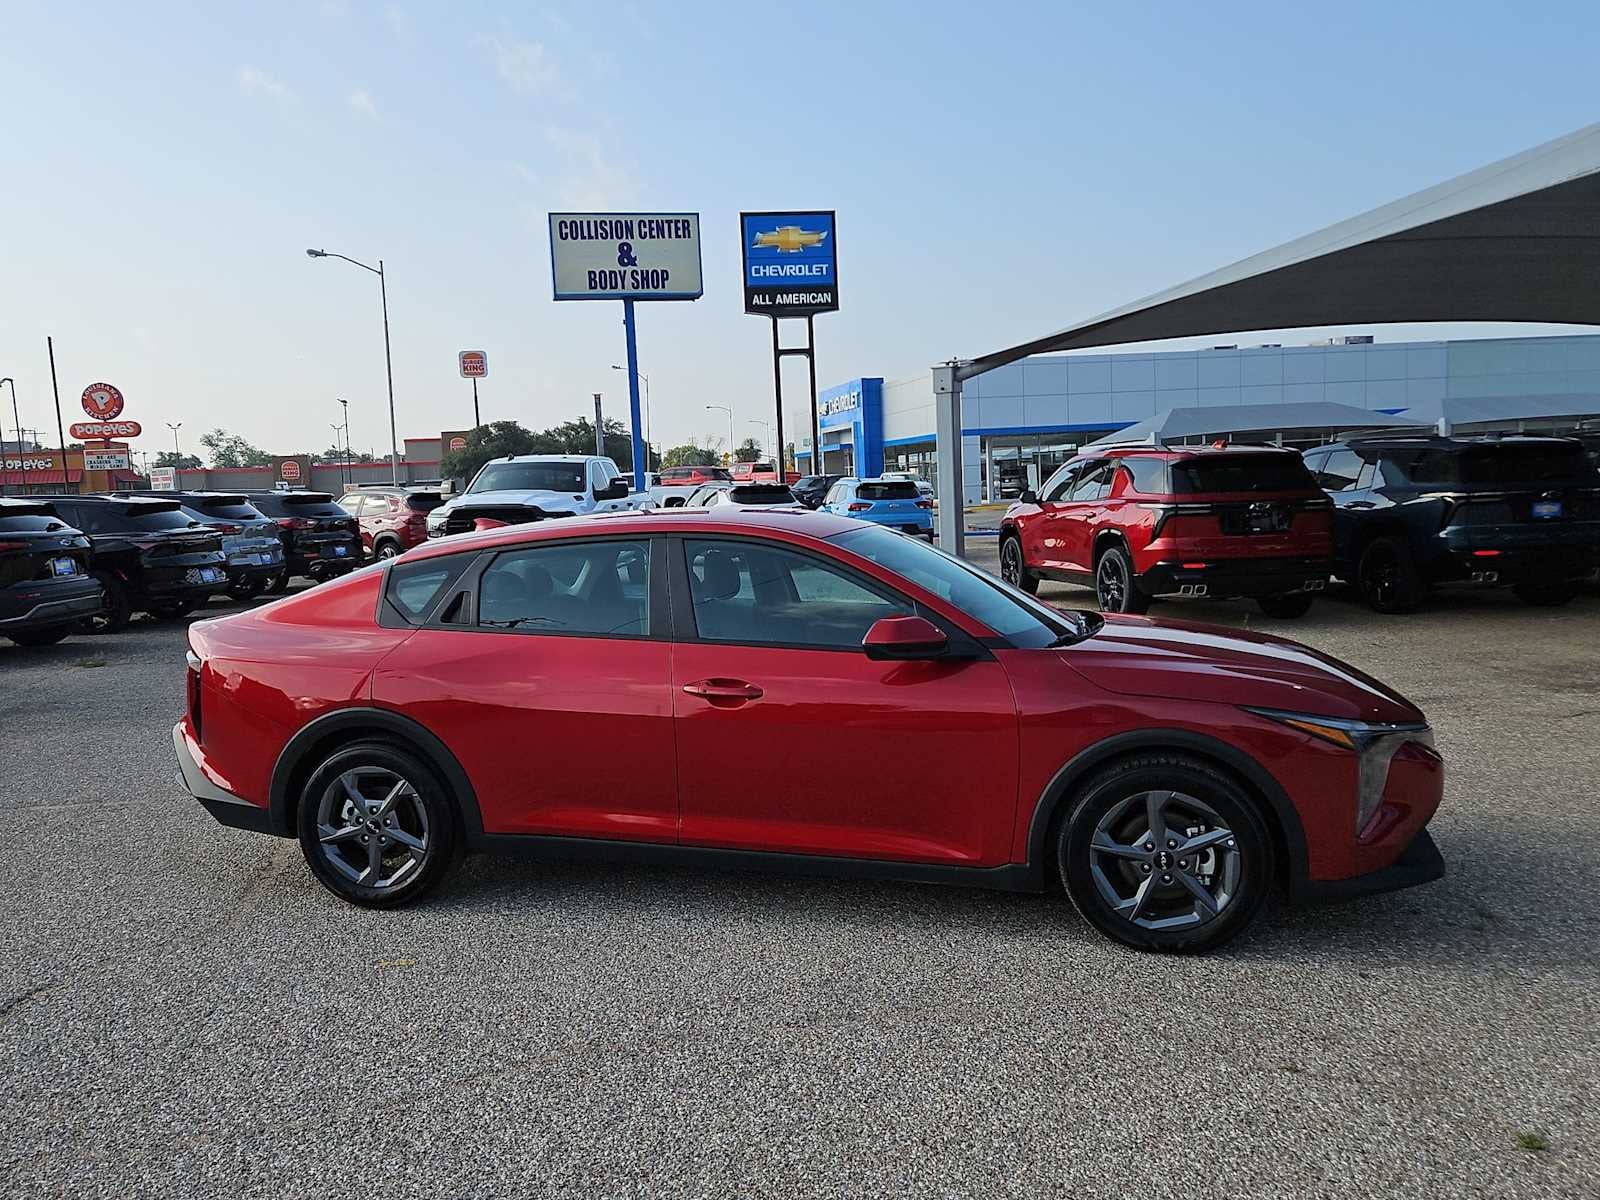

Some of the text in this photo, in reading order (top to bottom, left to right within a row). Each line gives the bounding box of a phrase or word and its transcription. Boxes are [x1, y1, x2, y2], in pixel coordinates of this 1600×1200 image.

[558, 219, 692, 241] COLLISION CENTER
[617, 241, 638, 267] &
[752, 263, 829, 277] CHEVROLET
[587, 269, 670, 290] BODY SHOP
[752, 292, 832, 306] ALL AMERICAN
[463, 364, 485, 372] KING
[83, 384, 119, 400] LOUISIANA
[828, 391, 859, 413] CHEVROLET
[85, 406, 119, 419] KITCHEN
